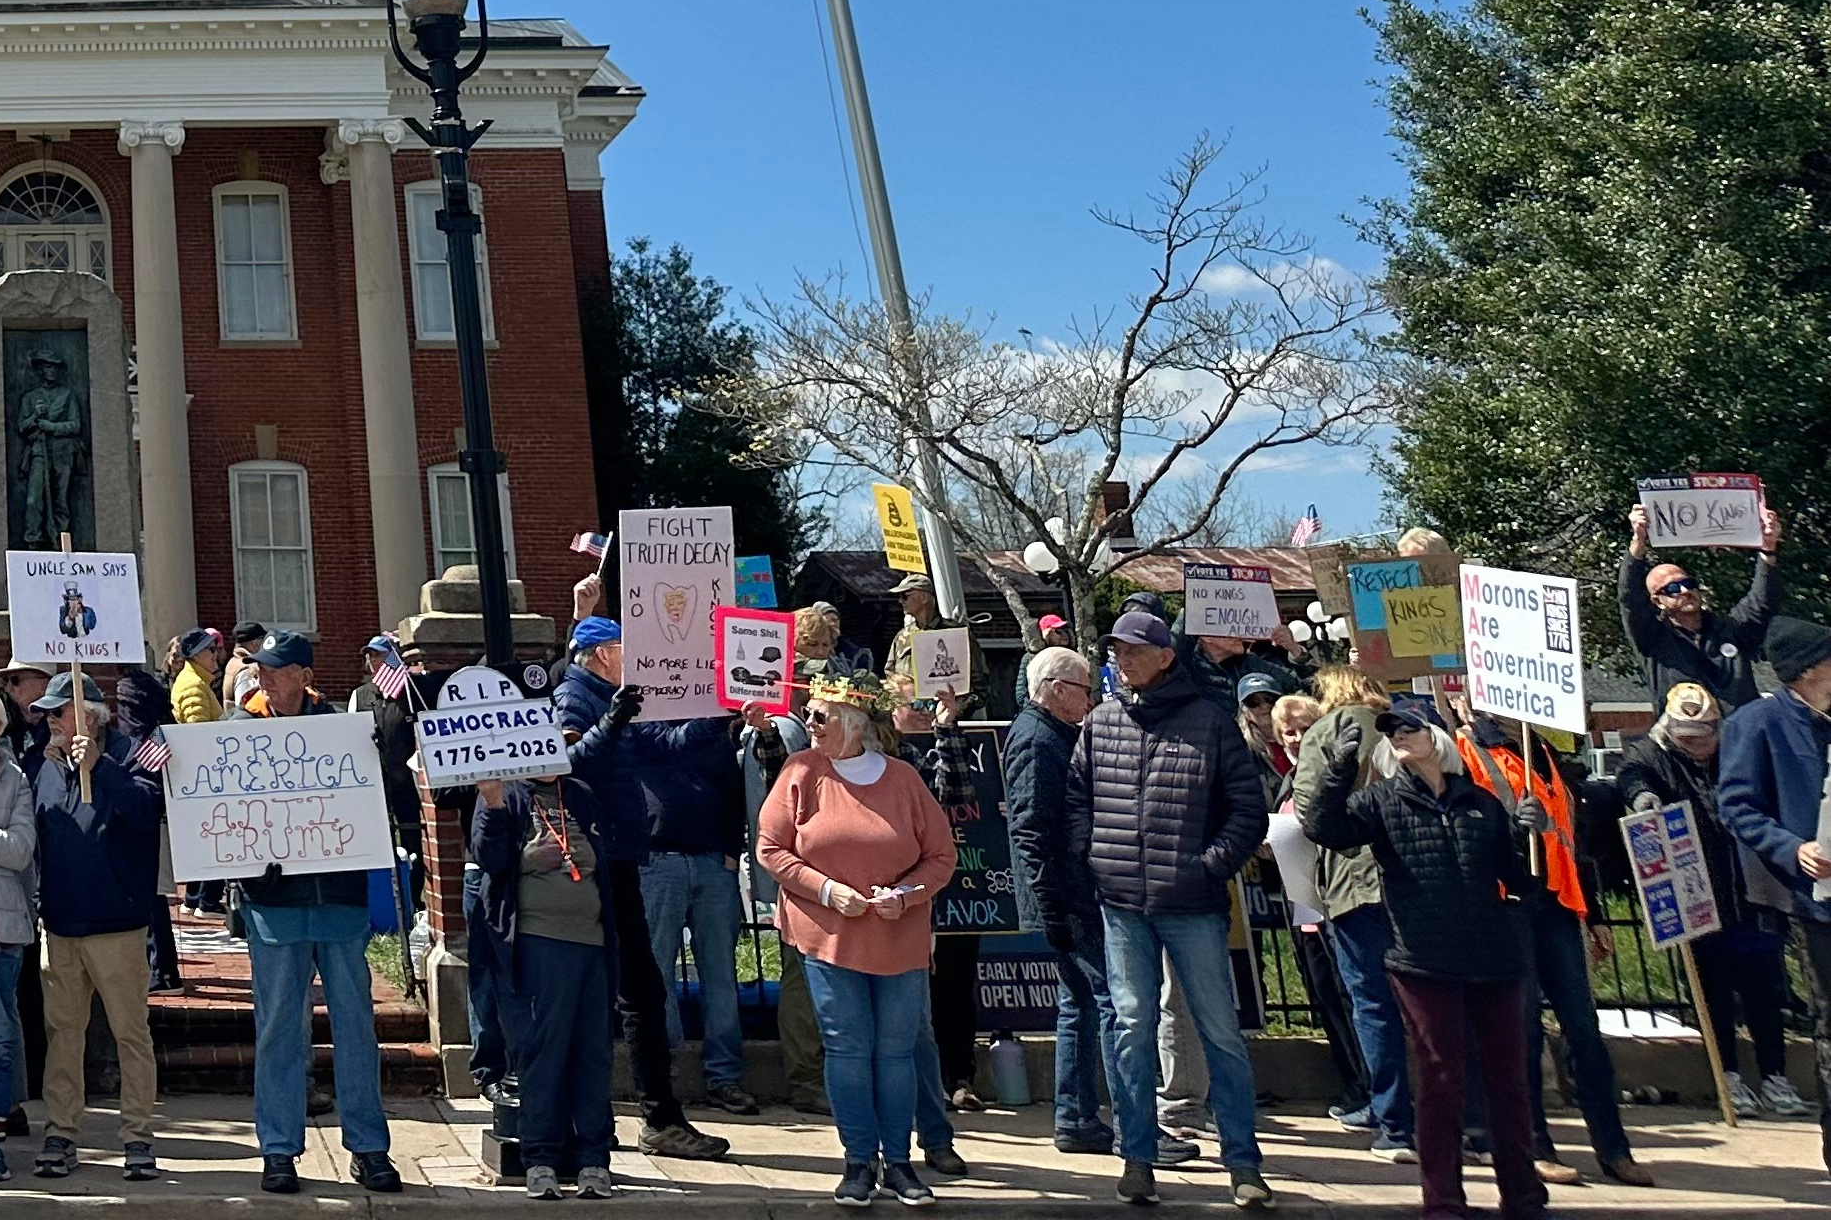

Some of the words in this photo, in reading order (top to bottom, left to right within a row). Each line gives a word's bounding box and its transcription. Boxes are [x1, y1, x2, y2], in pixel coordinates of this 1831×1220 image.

[1693, 476, 1727, 488] STOP
[647, 517, 713, 537] FIGHT
[1653, 499, 1698, 537] NO
[26, 560, 65, 577] UNCLE
[70, 562, 96, 576] SAM
[101, 562, 127, 577] SAYS
[623, 542, 679, 565] TRUTH
[683, 542, 731, 567] DECAY
[1231, 567, 1254, 579] STOP
[1350, 563, 1416, 594] REJECT
[1192, 588, 1208, 599] NO
[1214, 587, 1245, 600] KINGS
[1464, 573, 1539, 612] Morons
[1204, 606, 1260, 626] ENOUGH
[1387, 595, 1446, 625] KINGS
[1468, 607, 1500, 639] Are
[45, 640, 66, 657] NO
[75, 640, 109, 658] KINGS
[1470, 640, 1576, 695] Governing
[1475, 674, 1556, 719] America
[422, 705, 555, 737] DEMOCRACY
[216, 731, 306, 765] PRO
[181, 753, 368, 795] AMERICA
[201, 794, 340, 830] ANTI
[199, 823, 355, 863] TRUMP
[976, 961, 1019, 981] EARLY
[1020, 961, 1059, 981] VOTIN
[980, 985, 1028, 1009] OPEN
